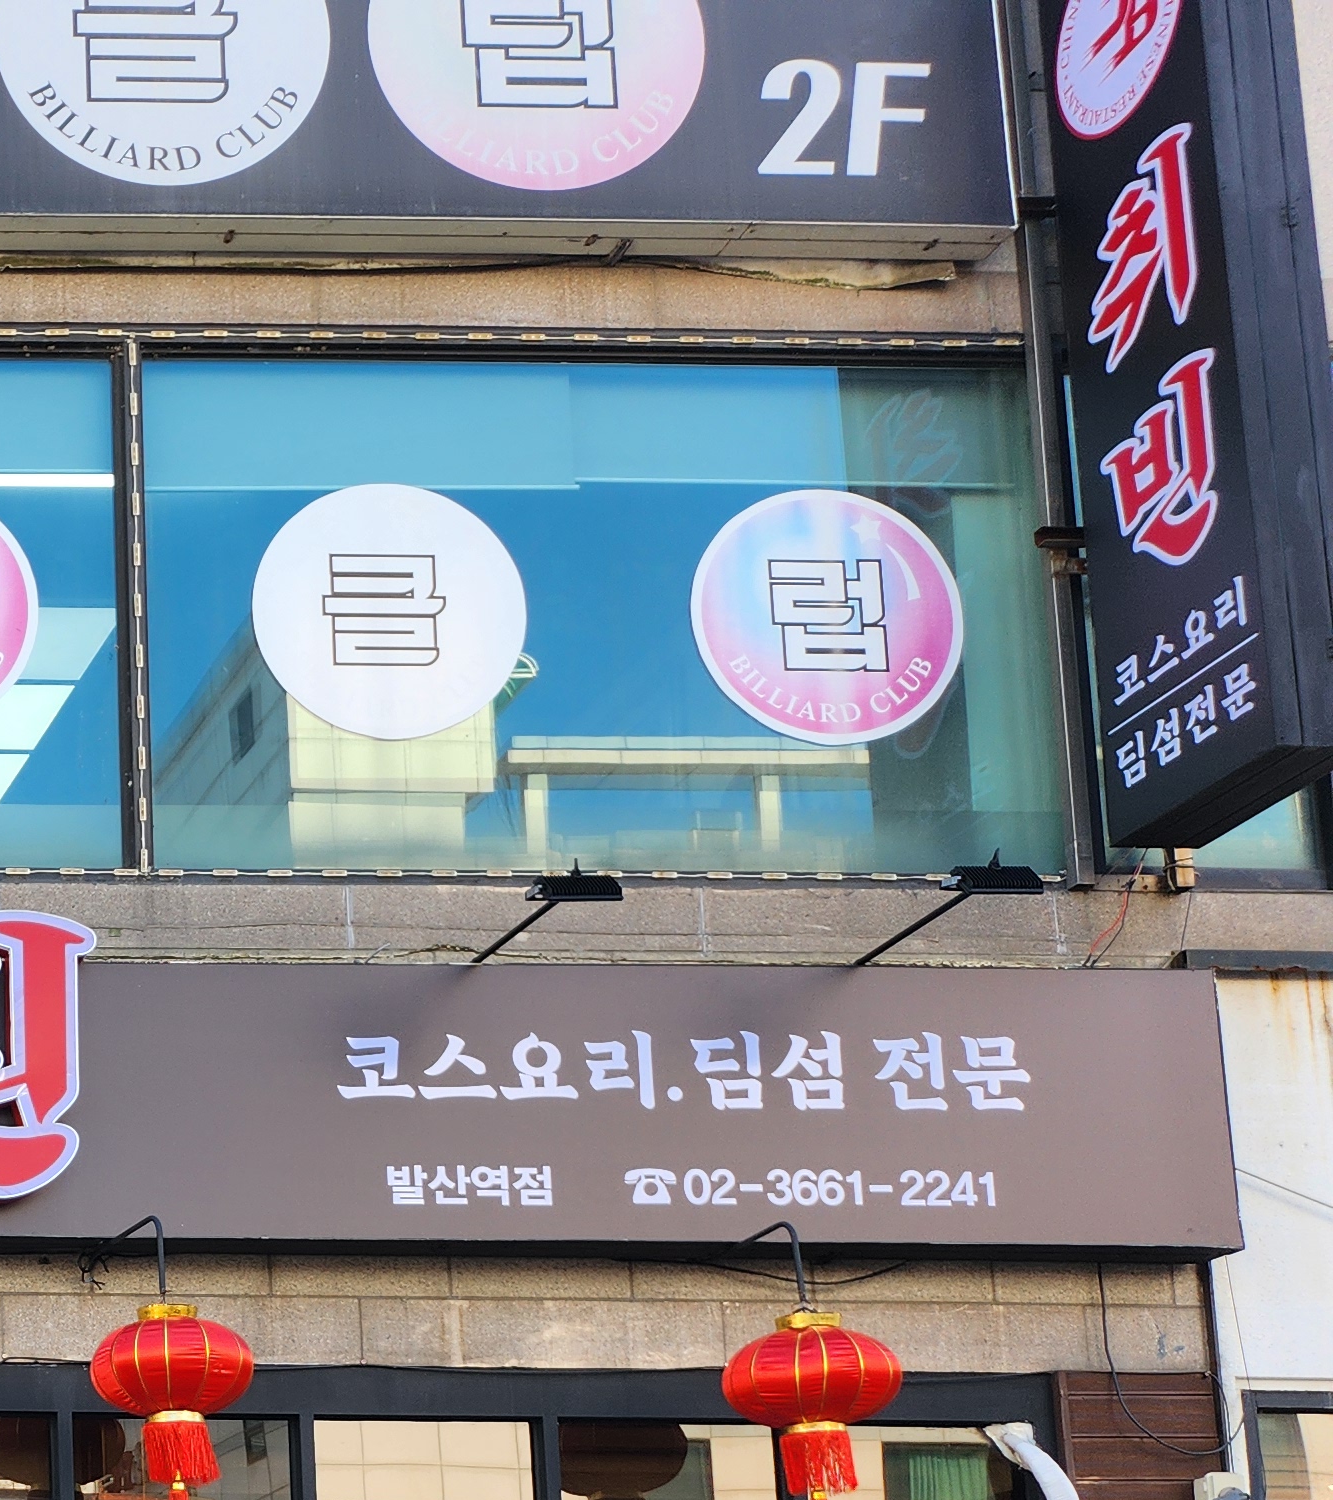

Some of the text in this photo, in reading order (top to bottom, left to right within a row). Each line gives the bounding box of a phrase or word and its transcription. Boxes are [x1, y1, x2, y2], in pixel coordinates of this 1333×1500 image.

[29, 79, 299, 173] BILLIARD CLUB
[407, 86, 677, 178] BILLIARD CLUB
[757, 59, 932, 178] 2F
[1088, 121, 1219, 567] 취빈
[1113, 574, 1250, 708] 코스요리
[728, 654, 935, 725] BILLIARD CLUB
[872, 1031, 1032, 1113] 전문
[386, 1164, 998, 1208] 발산역점 02-3661-2241
